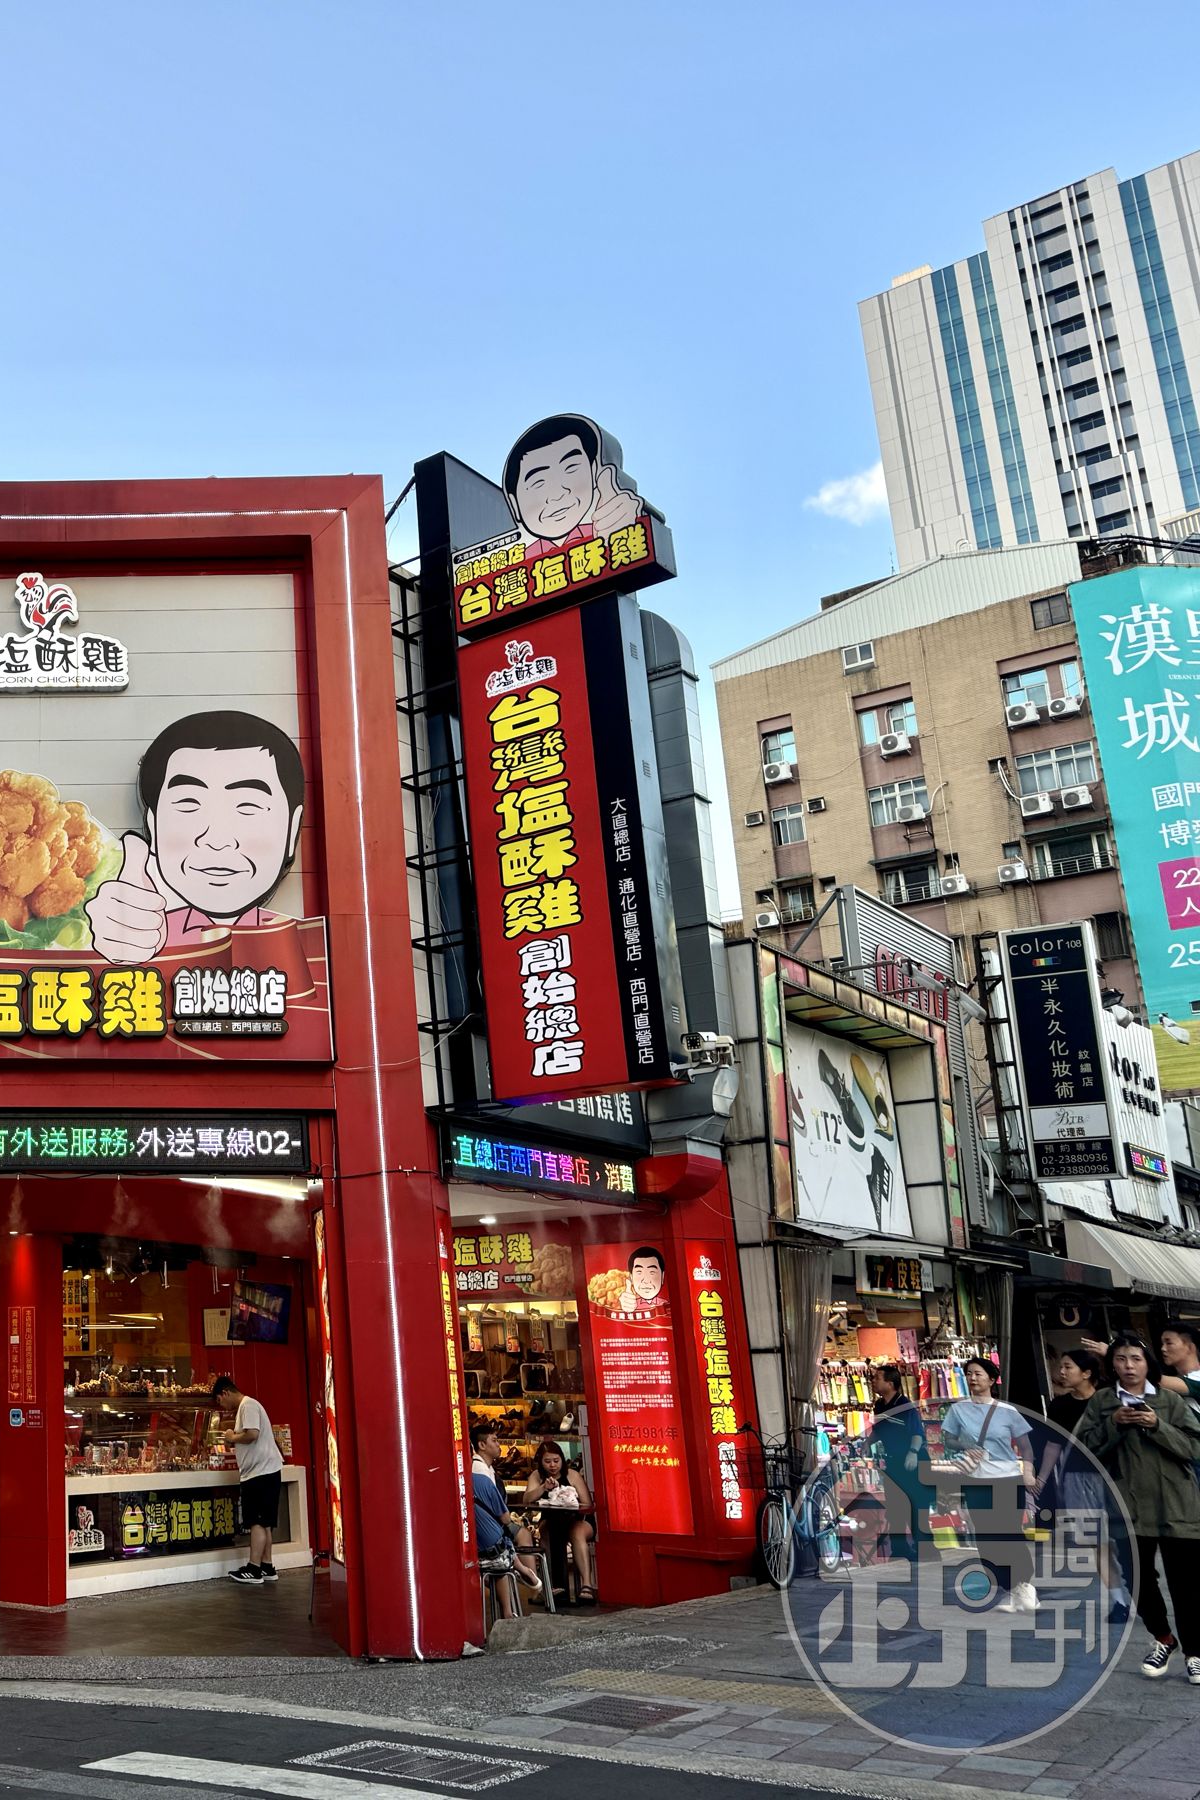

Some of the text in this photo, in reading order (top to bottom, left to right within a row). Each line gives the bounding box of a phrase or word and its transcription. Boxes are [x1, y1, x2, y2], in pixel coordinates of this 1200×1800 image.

[456, 543, 525, 585] 創始總店
[458, 524, 648, 623] 台灣塩酥雞
[1098, 603, 1200, 676] 漢
[37, 675, 91, 684] CHICKEN
[94, 675, 125, 684] KING
[1117, 688, 1200, 760] 城
[487, 686, 582, 939] 台灣塩酥雞
[174, 969, 286, 1015] 創始總店
[518, 934, 584, 1077] 創始總店
[1041, 1152, 1108, 1165] 02-23880936
[1057, 1127, 1086, 1138] 代理商
[697, 1290, 738, 1436] 台灣塩酥雞
[608, 1424, 678, 1441] 創立1981年
[716, 1441, 744, 1520] 創始總店
[121, 1498, 235, 1546] 台灣塩酥雞
